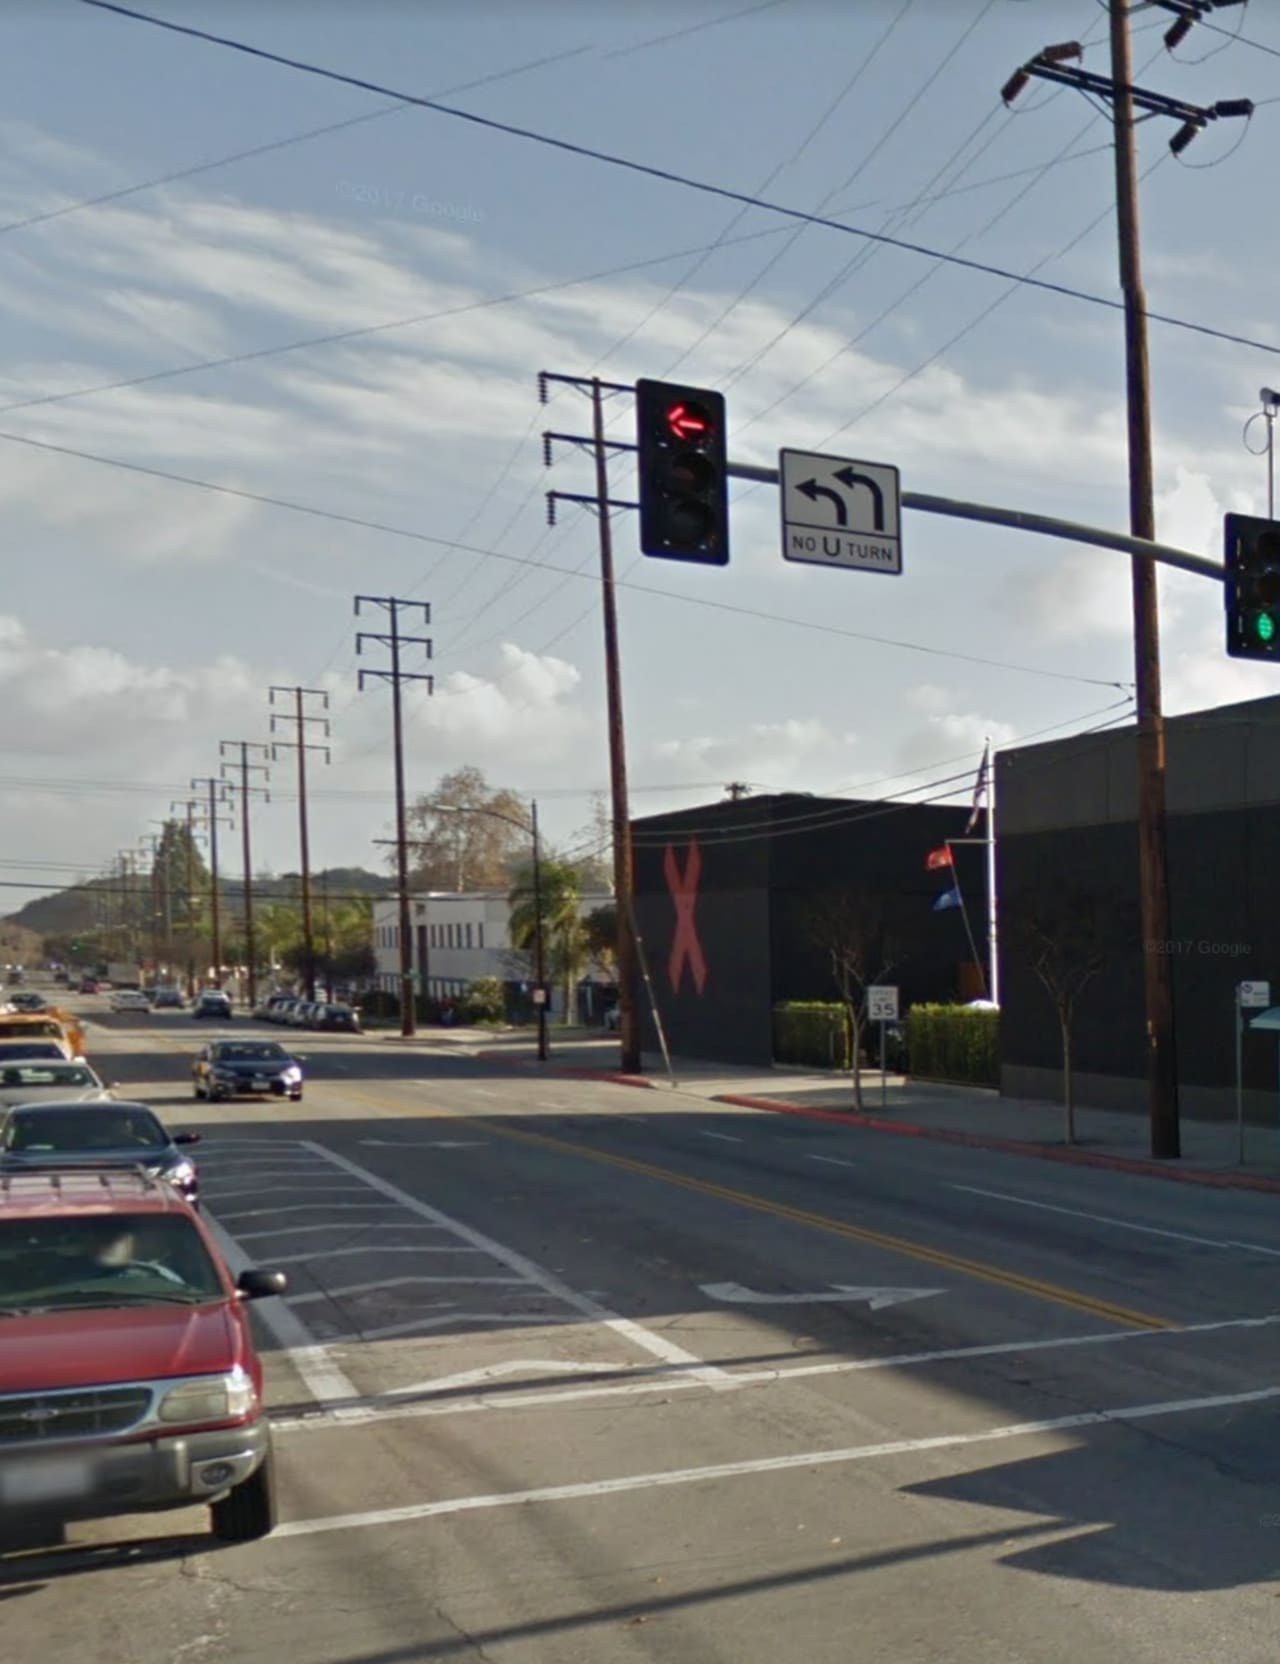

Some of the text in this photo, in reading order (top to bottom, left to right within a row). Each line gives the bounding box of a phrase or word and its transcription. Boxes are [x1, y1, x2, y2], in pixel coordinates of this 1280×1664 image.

[792, 535, 893, 561] NO U TURN
[871, 1002, 895, 1017] 35
